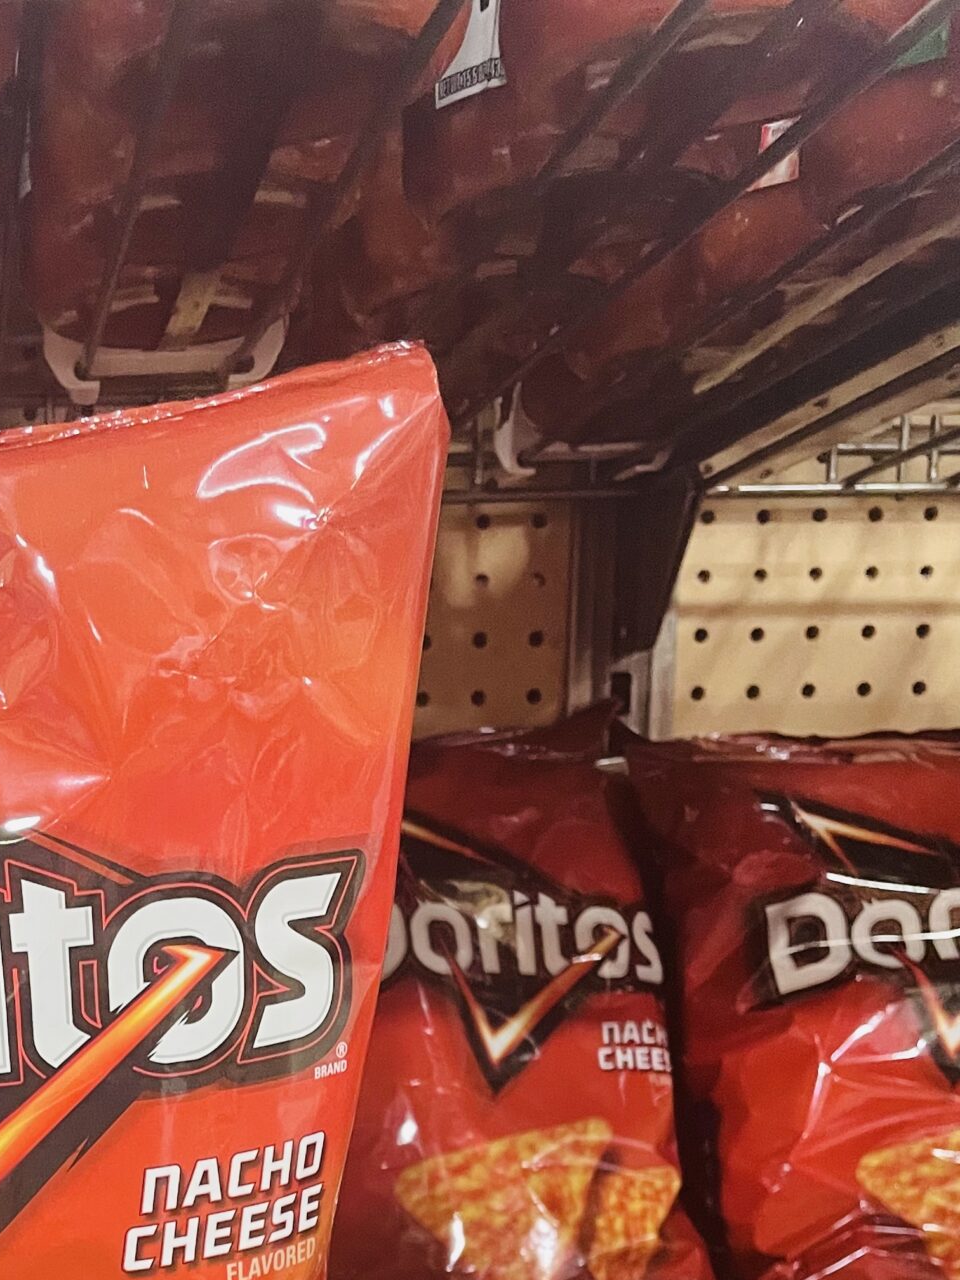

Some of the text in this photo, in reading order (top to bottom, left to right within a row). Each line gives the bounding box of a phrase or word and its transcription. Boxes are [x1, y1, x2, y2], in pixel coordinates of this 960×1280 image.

[314, 1059, 348, 1081] BRAND
[140, 1131, 326, 1216] NACHO
[122, 1183, 324, 1273] CHEESE
